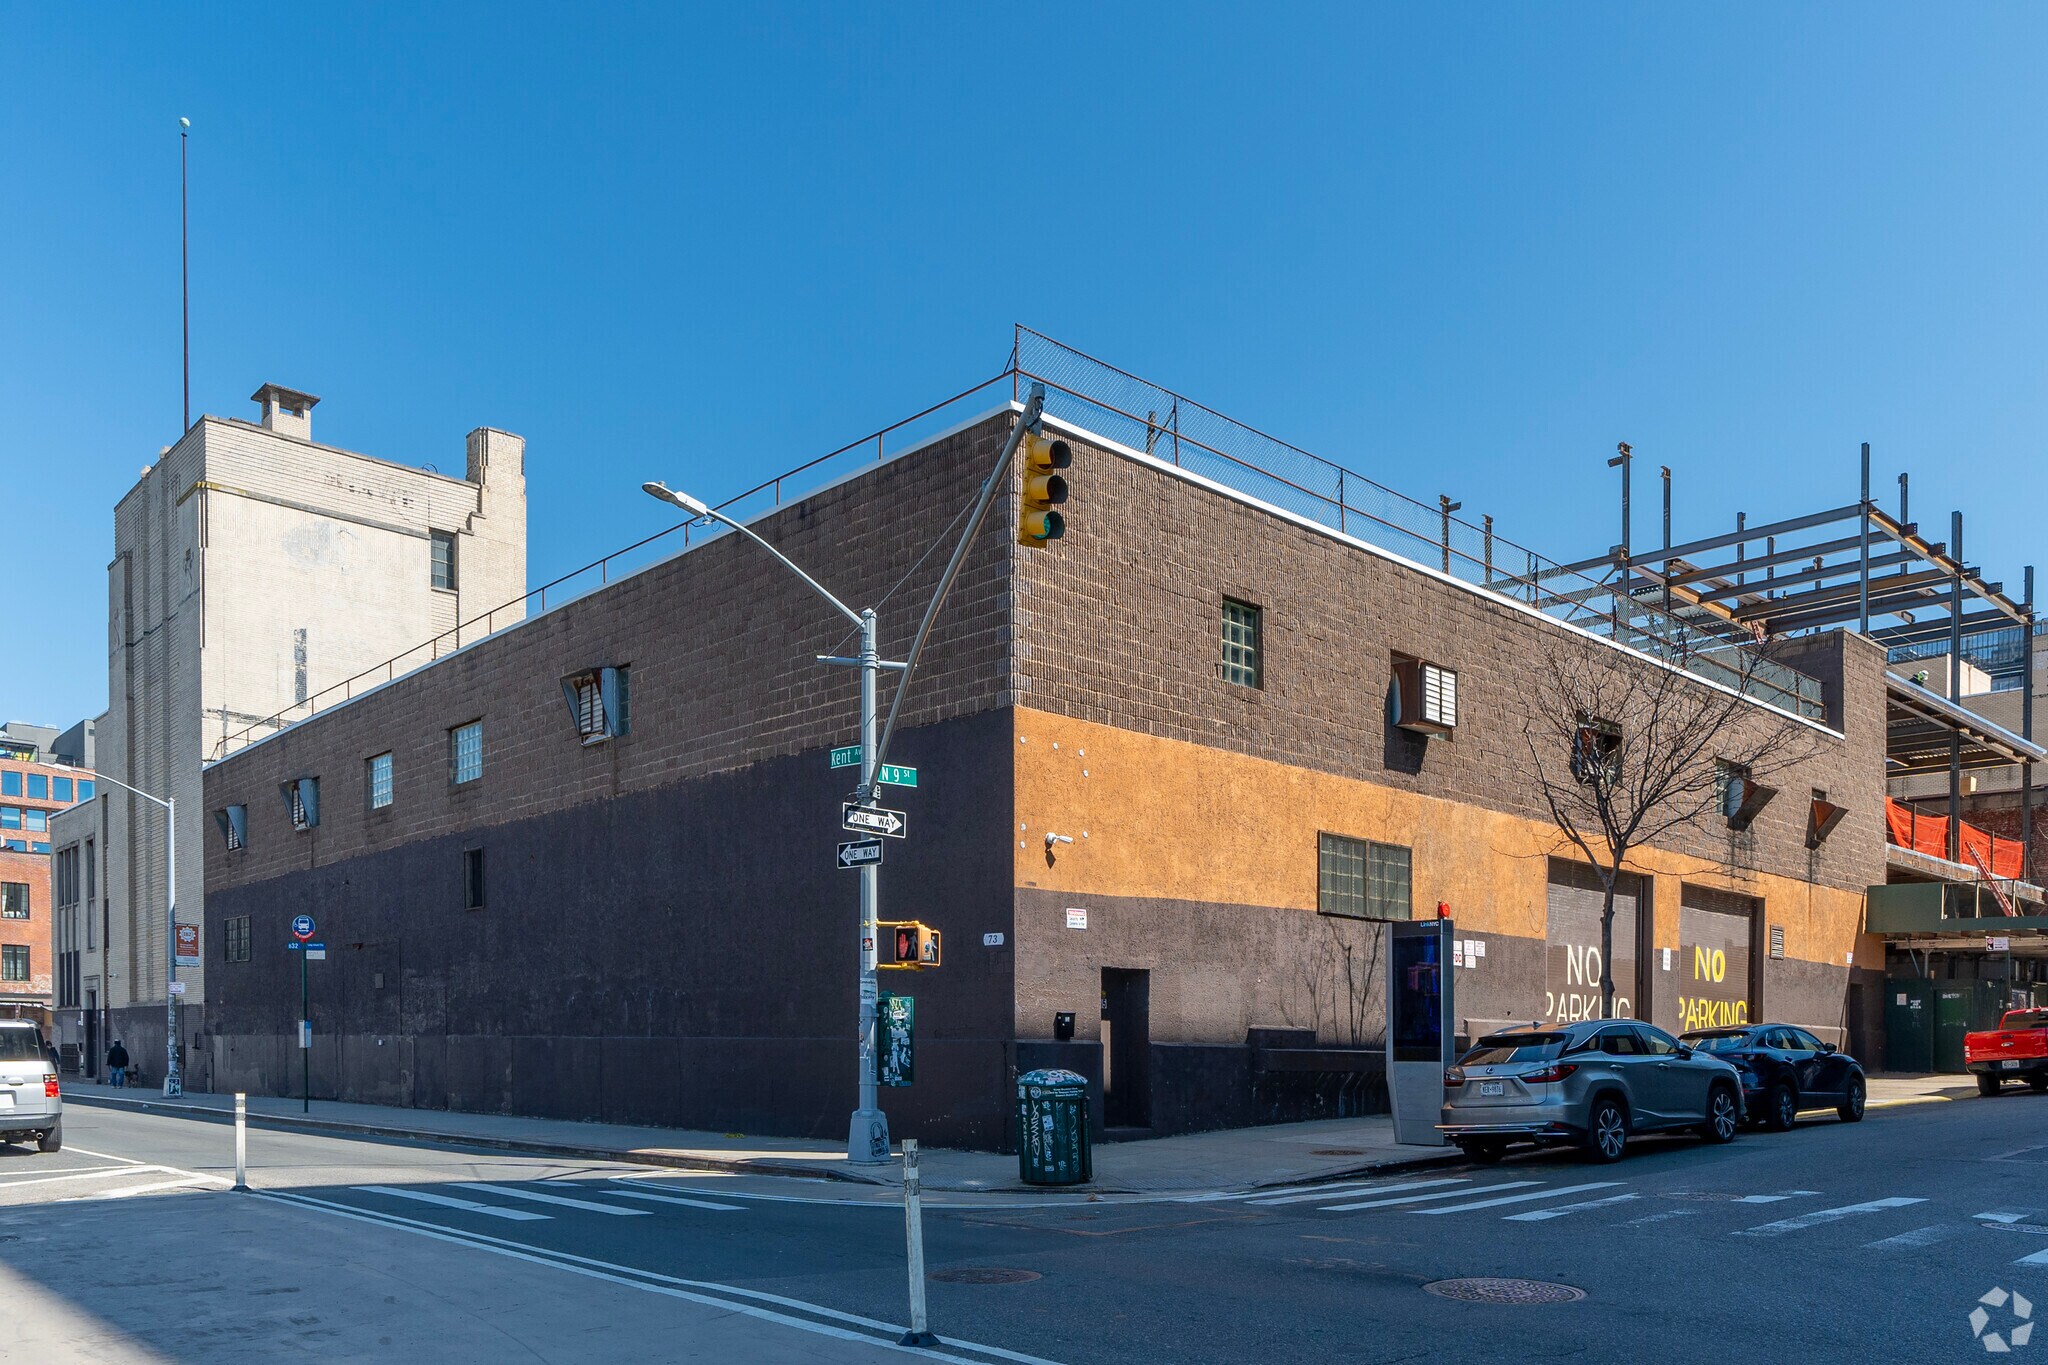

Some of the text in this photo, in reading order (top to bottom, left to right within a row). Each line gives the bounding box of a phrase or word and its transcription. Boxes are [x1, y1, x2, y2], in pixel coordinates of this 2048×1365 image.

[831, 749, 851, 766] Kent
[881, 766, 910, 782] N 9 St
[852, 812, 896, 829] ONE WAY
[844, 847, 877, 860] ONE WAY
[988, 934, 998, 944] 73
[1567, 944, 1602, 987] NO
[1694, 945, 1726, 983] NO
[1679, 996, 1748, 1032] PARKING
